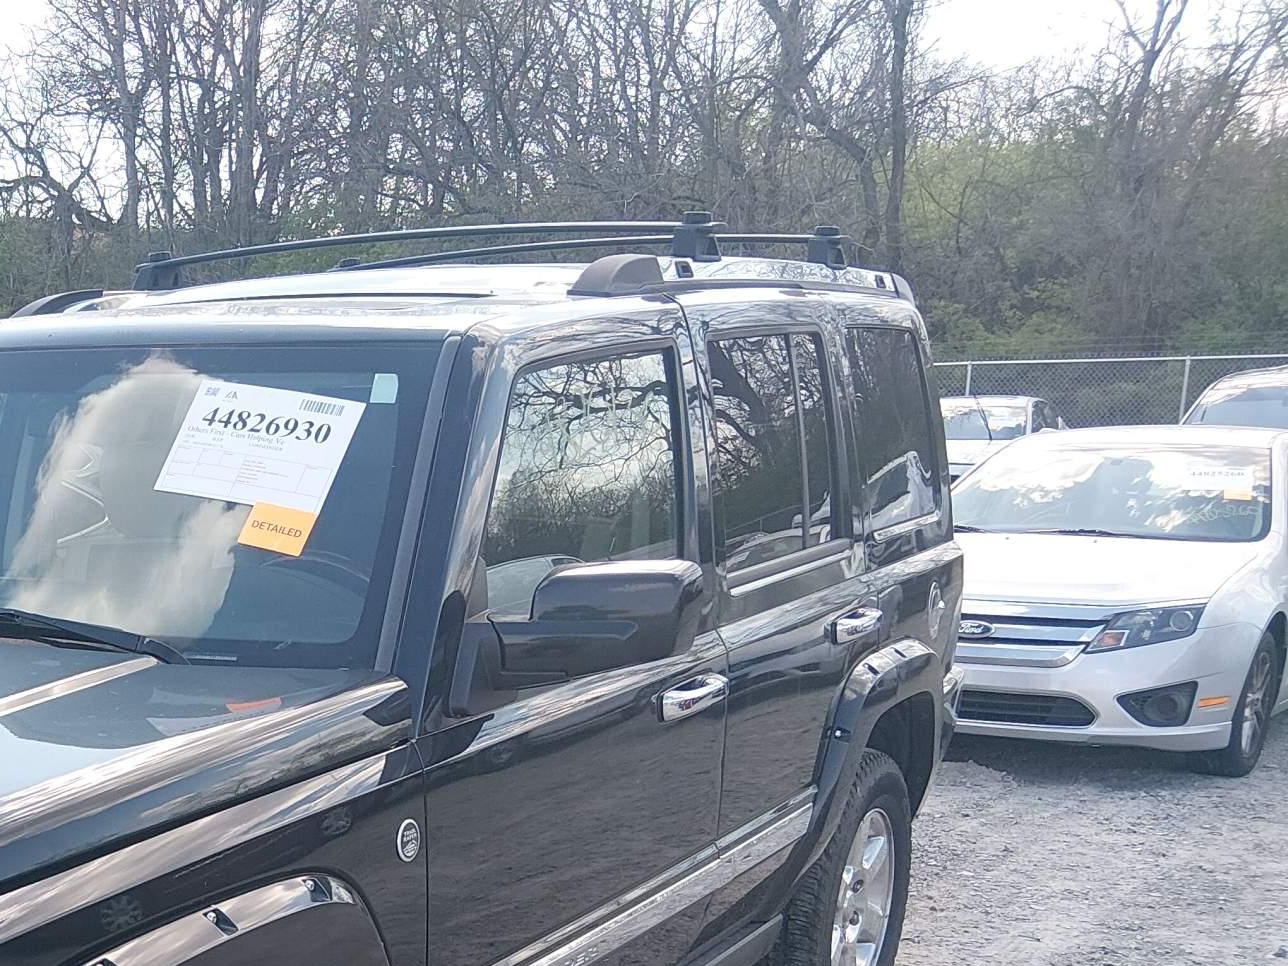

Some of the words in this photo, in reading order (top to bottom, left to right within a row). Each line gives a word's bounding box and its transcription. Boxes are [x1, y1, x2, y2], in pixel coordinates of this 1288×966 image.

[202, 407, 332, 444] 44826930
[251, 519, 302, 538] DETAILED
[958, 622, 985, 634] Ford
